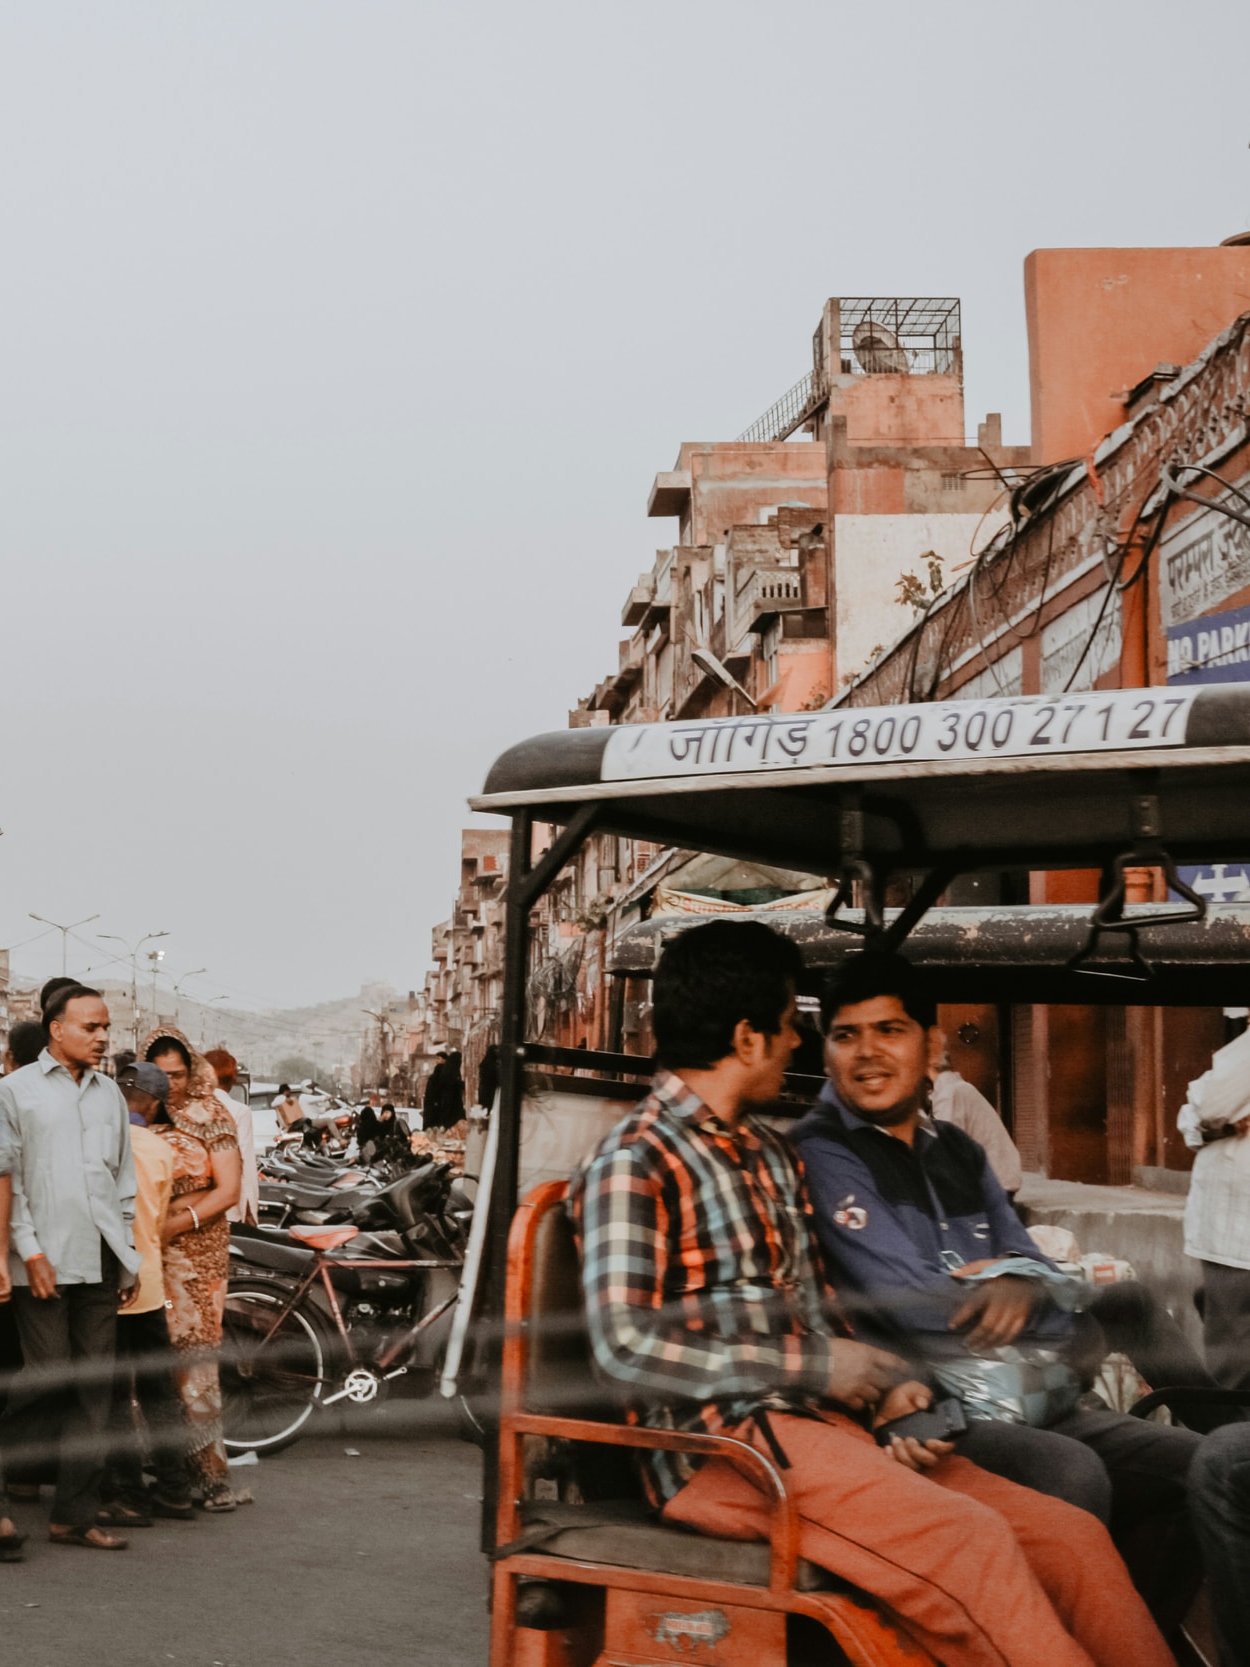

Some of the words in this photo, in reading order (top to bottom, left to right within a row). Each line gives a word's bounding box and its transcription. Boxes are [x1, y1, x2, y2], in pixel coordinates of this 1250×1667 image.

[1167, 636, 1193, 676] NO
[1197, 619, 1250, 669] PARK
[828, 714, 922, 758] 1800
[937, 709, 1014, 751] 300
